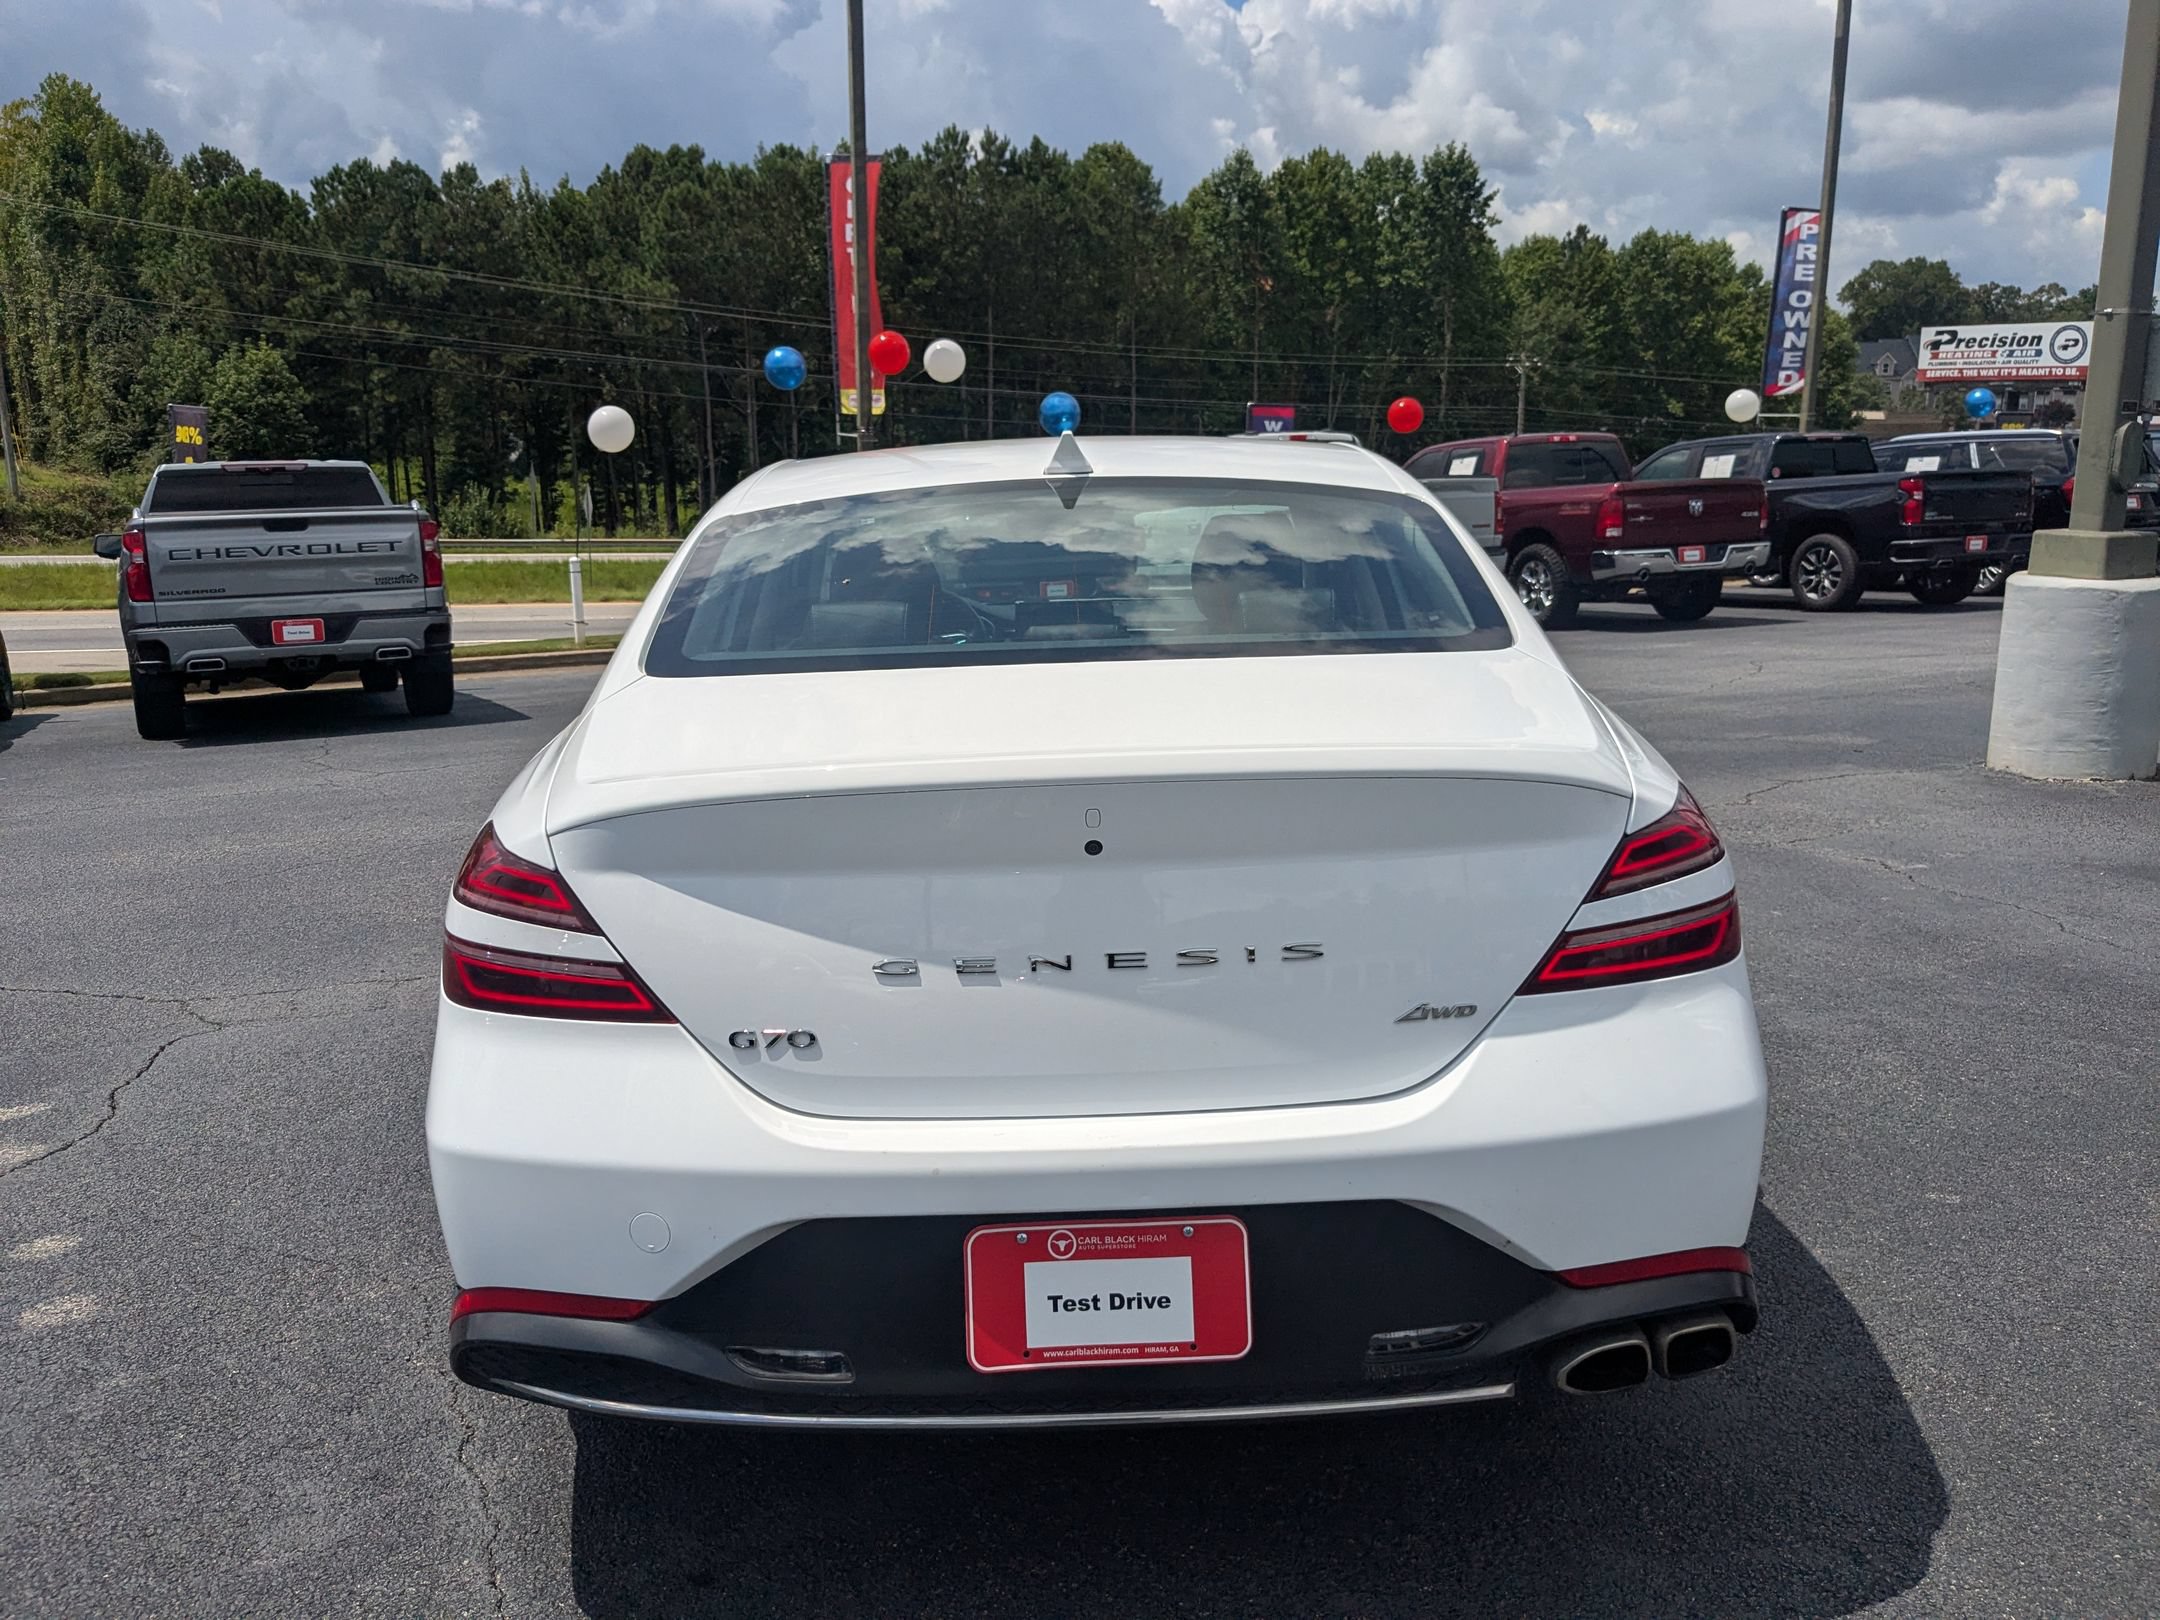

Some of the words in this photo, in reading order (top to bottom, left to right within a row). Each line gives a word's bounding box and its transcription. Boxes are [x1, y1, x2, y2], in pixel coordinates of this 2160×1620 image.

[1794, 223, 1819, 282] PRE
[1776, 290, 1812, 388] OWNED
[1930, 329, 2043, 350] Precision
[1938, 351, 1992, 359] HEATING
[1926, 370, 1961, 378] SERVICE.
[1963, 369, 1978, 377] THE
[1980, 369, 1998, 377] WAY
[2001, 368, 2017, 376] IT'S
[2018, 367, 2049, 376] MEANT
[2051, 367, 2062, 375] TO
[2065, 367, 2080, 375] BE.
[168, 541, 402, 561] CHEVROLET
[158, 588, 226, 596] SILVERADO
[872, 942, 1324, 975] GENESIS
[1394, 1003, 1477, 1022] AWD
[728, 1029, 816, 1049] G70
[1078, 1236, 1103, 1245] CARL
[1105, 1235, 1135, 1244] BLACK
[1137, 1234, 1167, 1243] HIRAM
[1047, 1293, 1101, 1313] Test
[1109, 1292, 1171, 1311] Drive
[1043, 1346, 1139, 1358] www.carlblackhiram.com
